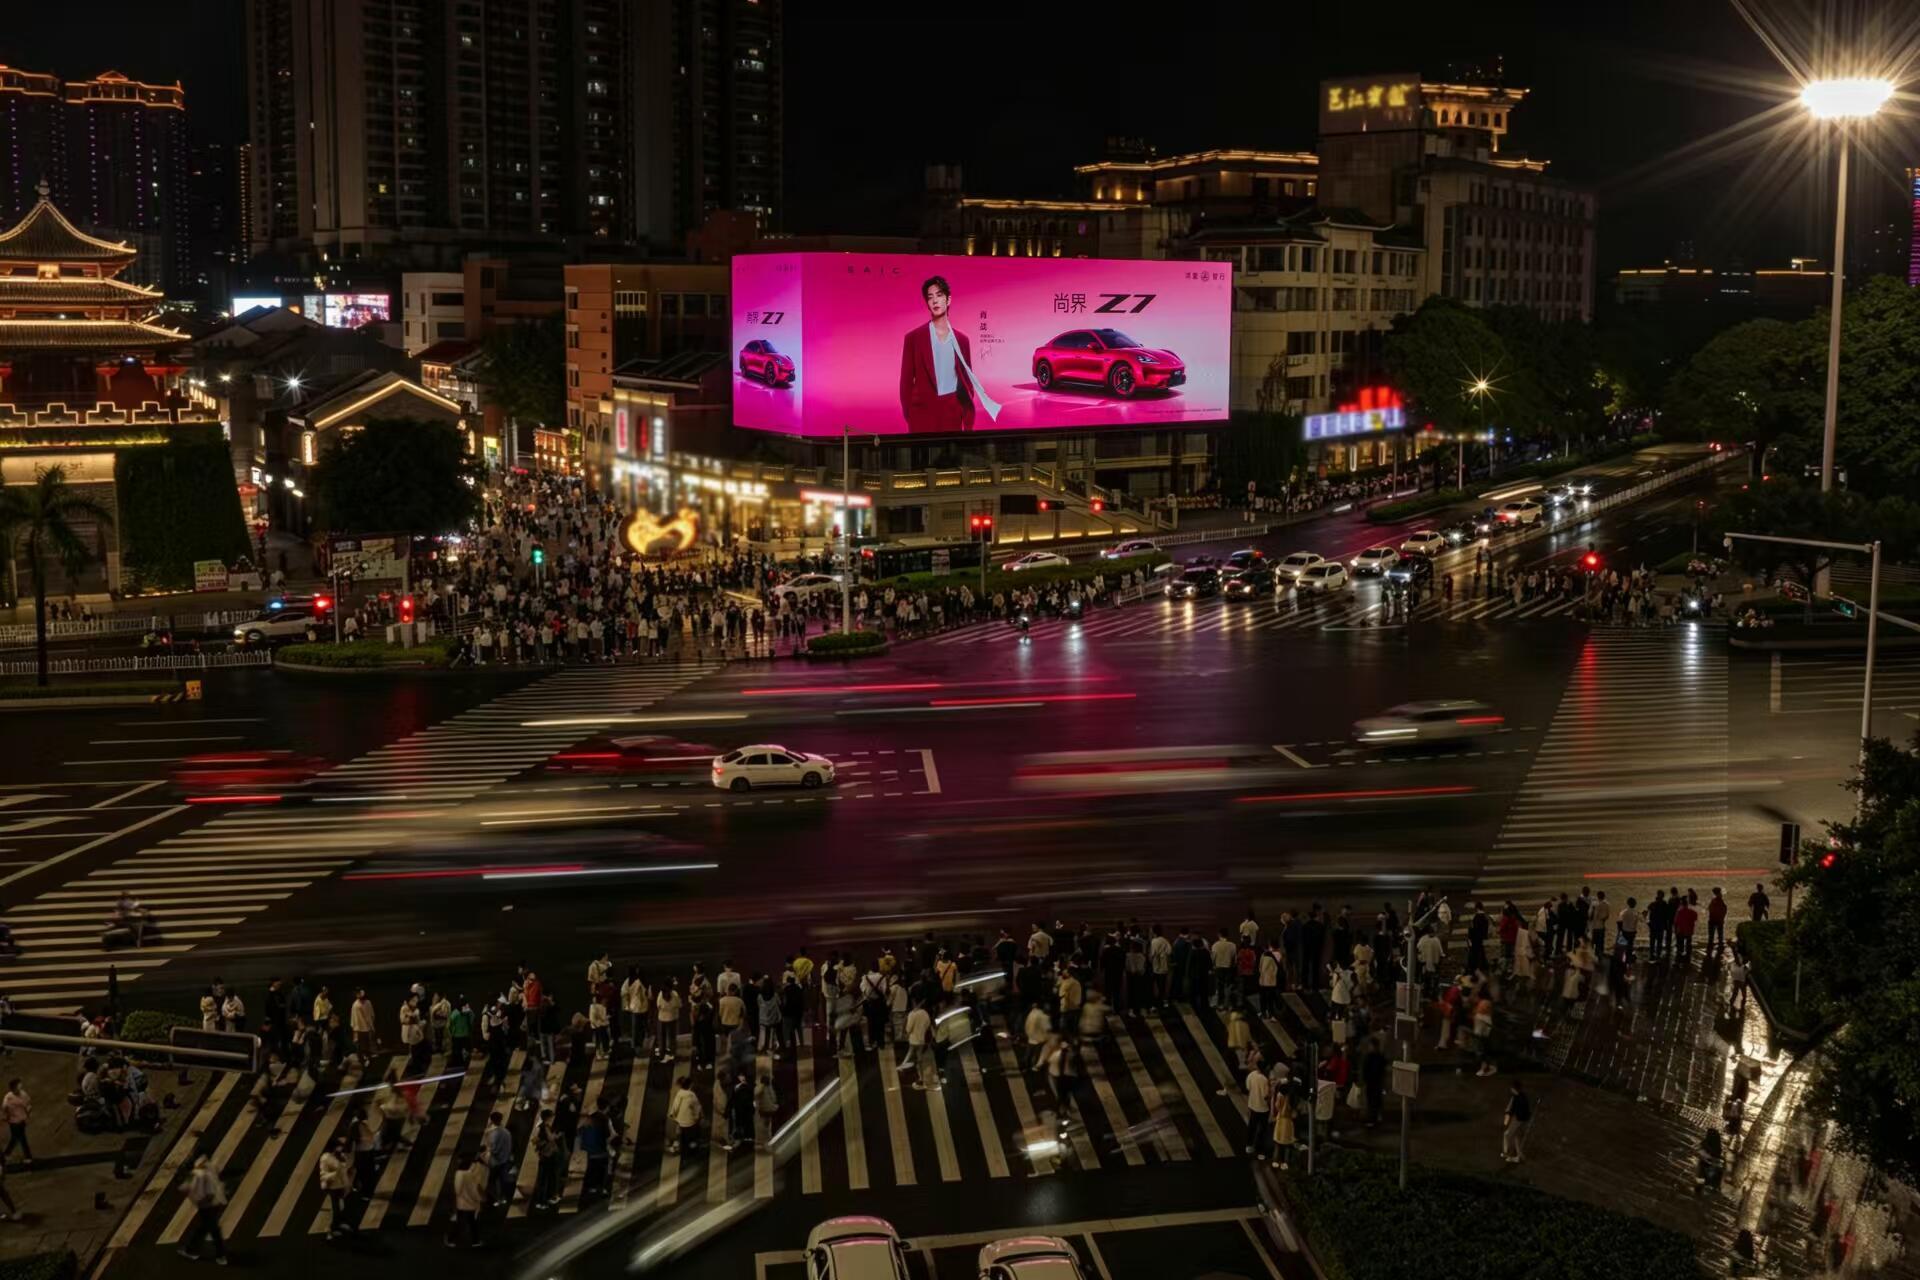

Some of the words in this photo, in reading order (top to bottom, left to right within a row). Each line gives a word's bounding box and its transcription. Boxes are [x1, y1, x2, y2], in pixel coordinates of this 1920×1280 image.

[1054, 293, 1087, 313] 尚界
[1093, 294, 1157, 314] Z7
[761, 311, 784, 324] Z7
